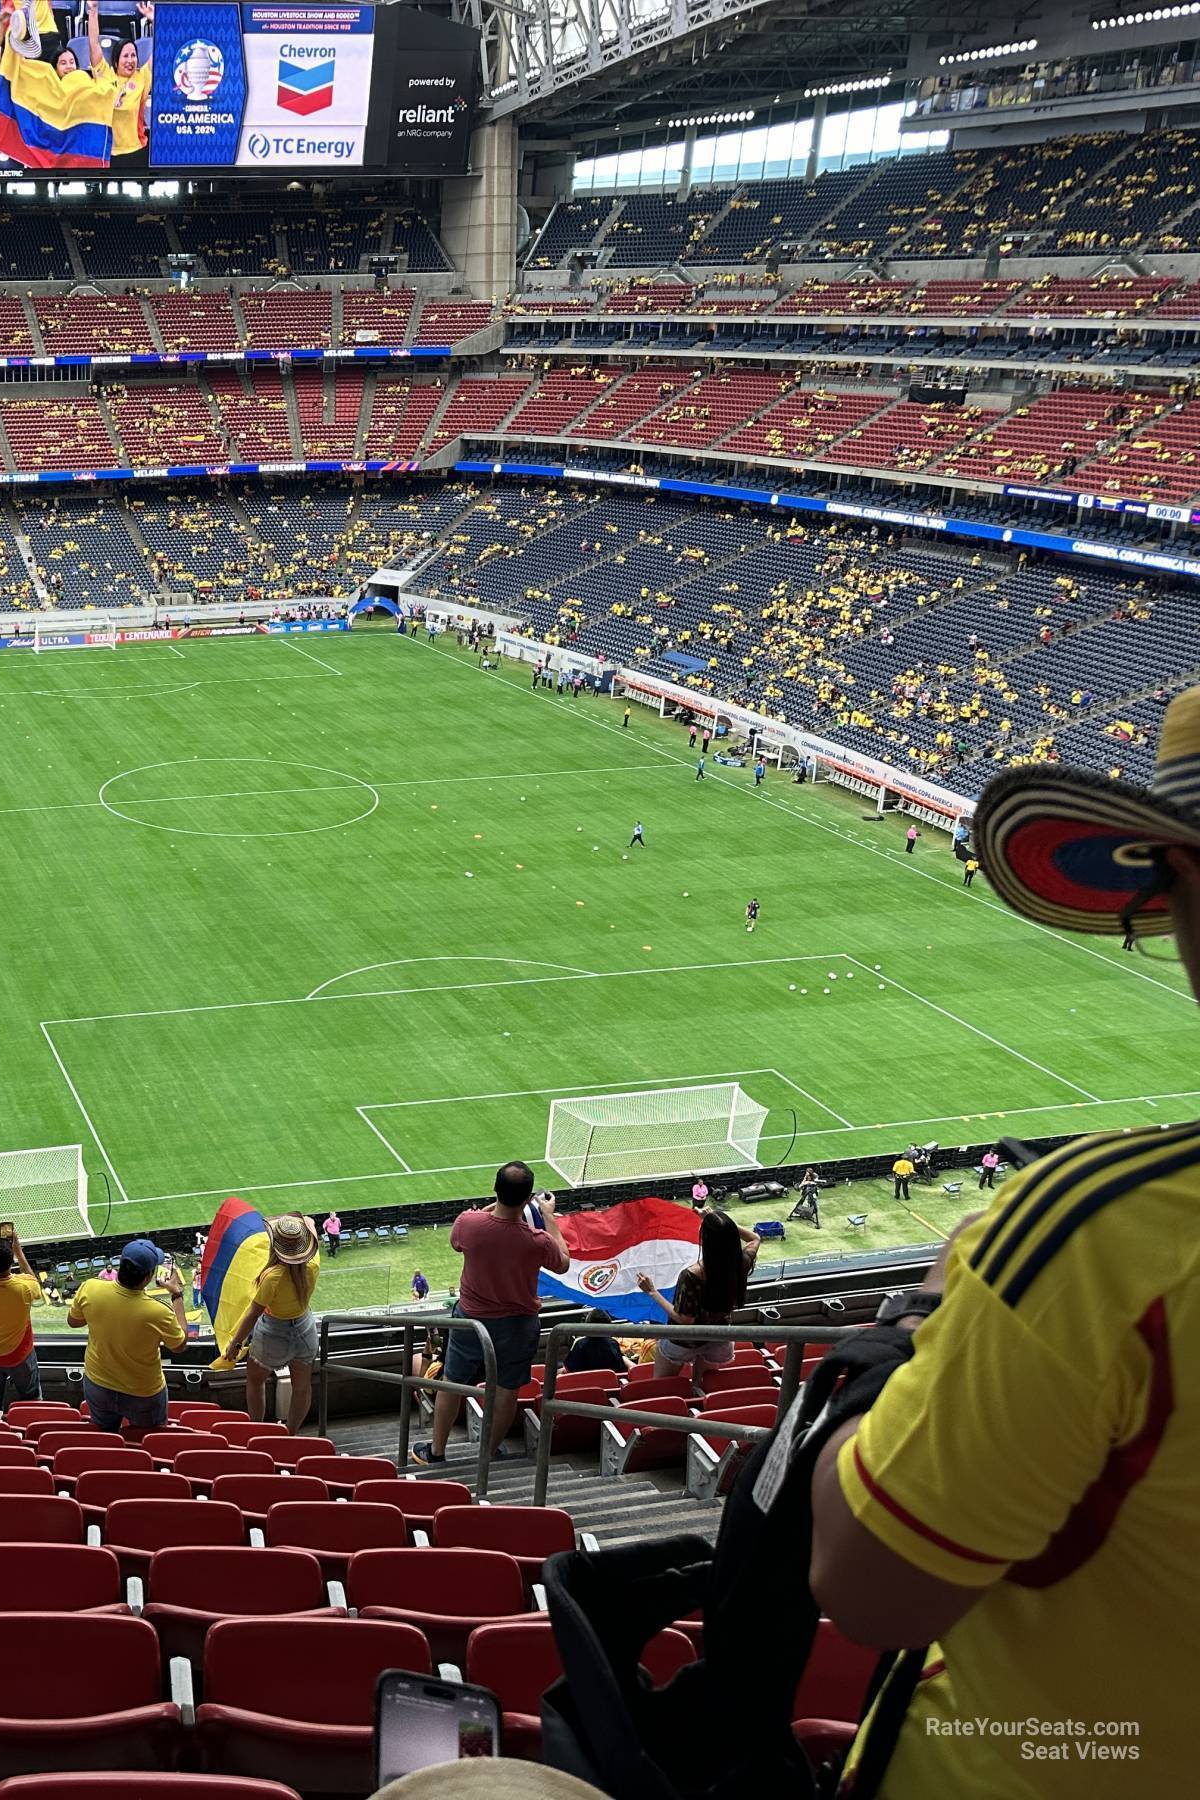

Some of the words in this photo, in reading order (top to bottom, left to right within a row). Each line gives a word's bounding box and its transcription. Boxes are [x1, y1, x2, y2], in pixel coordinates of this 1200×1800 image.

[280, 44, 336, 58] Chevron
[408, 76, 445, 88] powered
[445, 76, 456, 88] by
[158, 113, 186, 124] COPA
[186, 113, 235, 124] AMERICA
[398, 104, 455, 123] reliant
[176, 125, 193, 134] USA
[194, 125, 216, 135] 2024
[406, 129, 422, 137] NRG
[422, 130, 453, 139] company
[273, 138, 294, 154] TC
[296, 138, 355, 158] Energy
[324, 349, 355, 357] WELCOME
[133, 469, 169, 477] WELCOME
[41, 636, 70, 645] ULTRA
[892, 778, 918, 794] CONMEBOL
[917, 789, 931, 799] COPA
[931, 795, 953, 808] AMERICA
